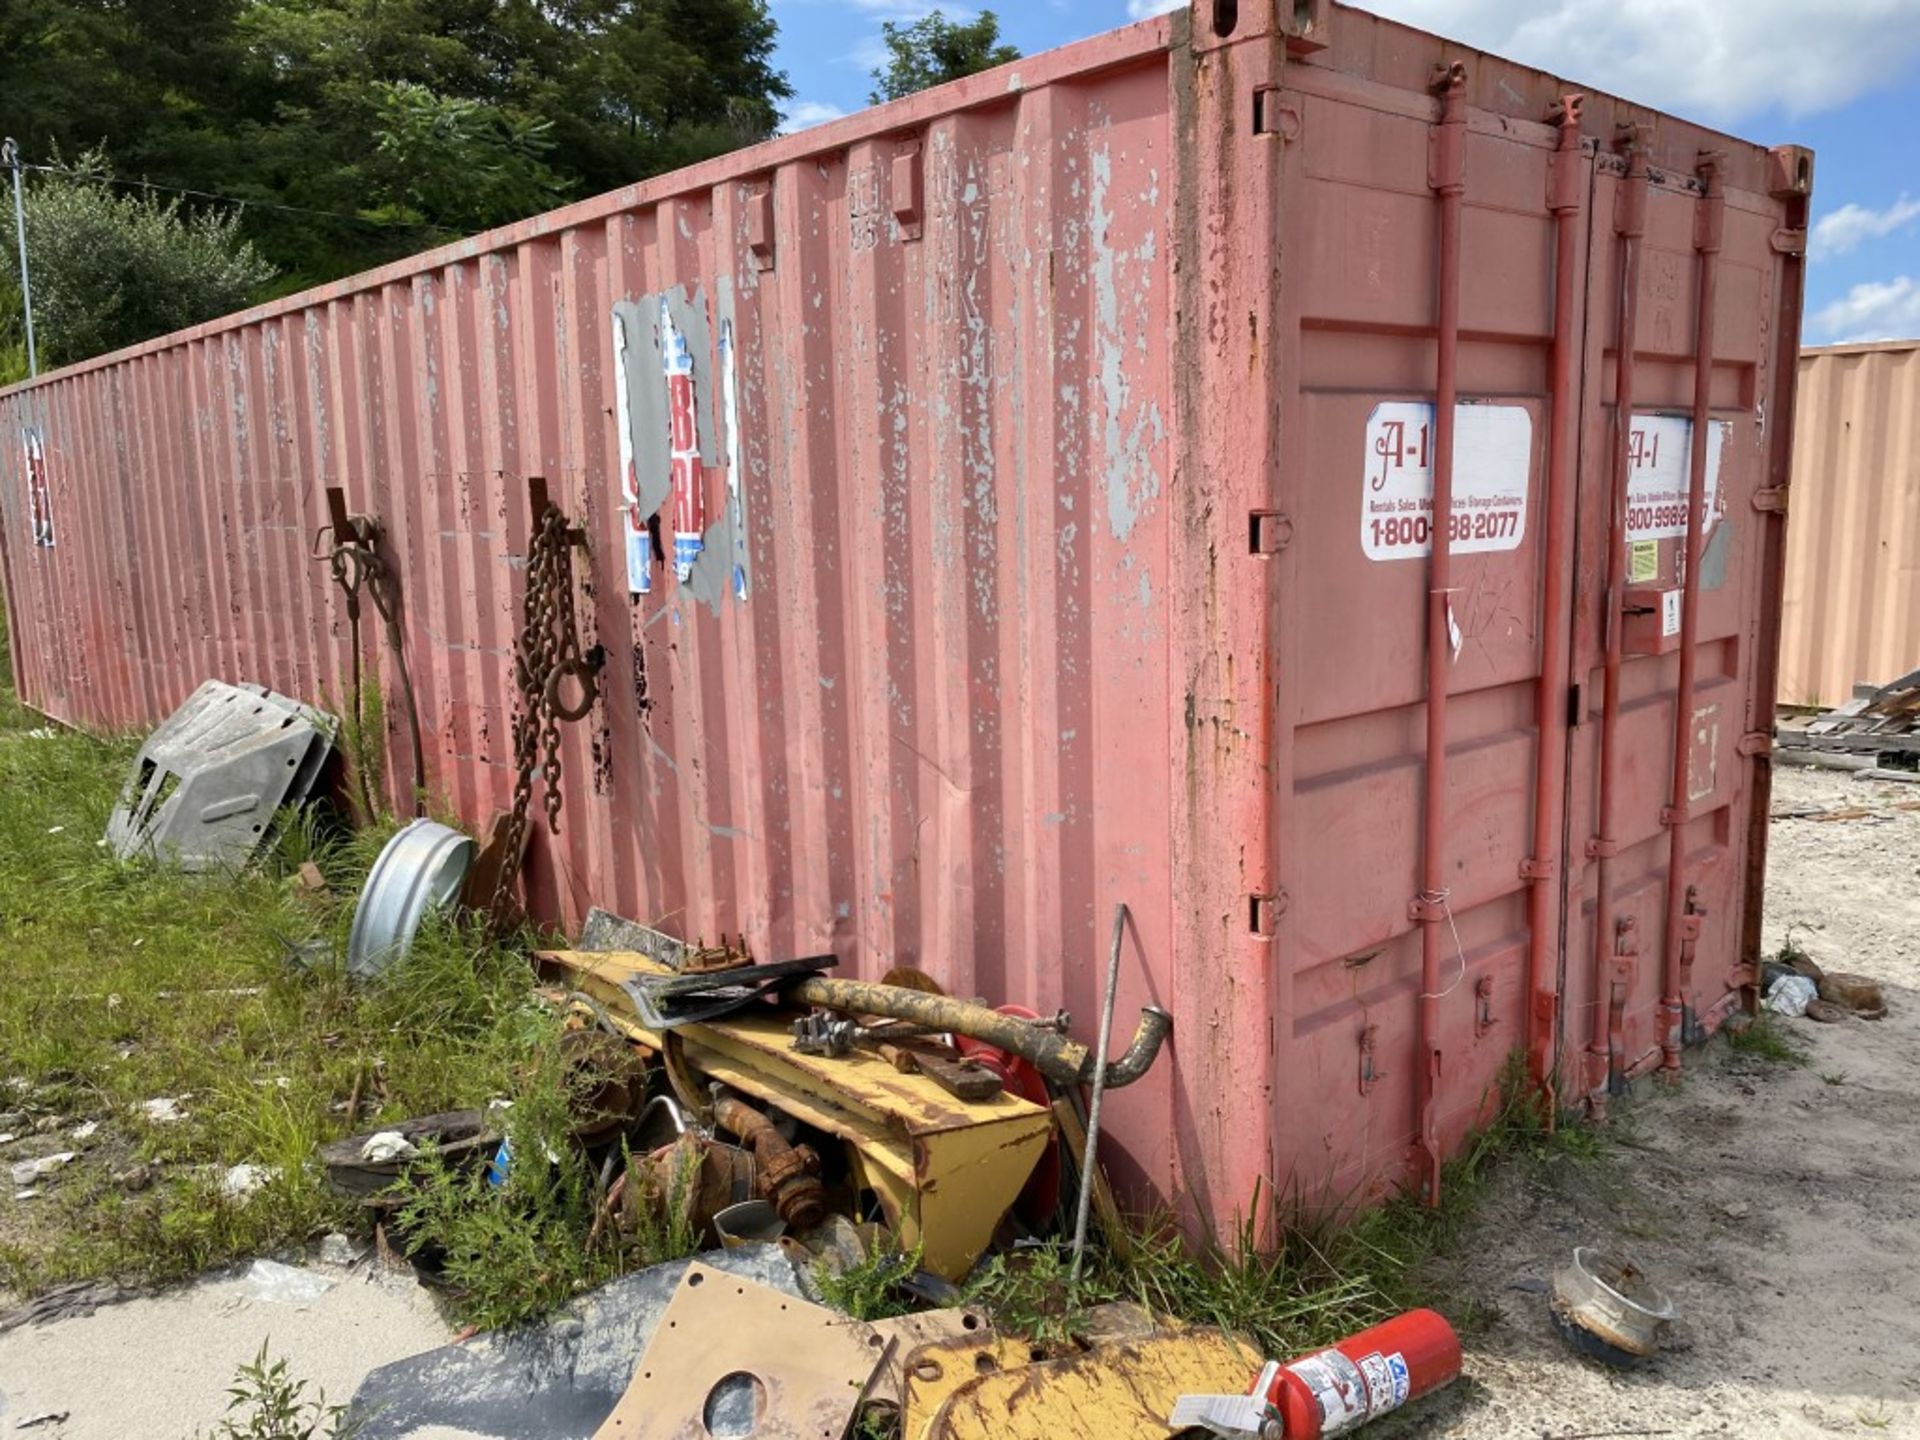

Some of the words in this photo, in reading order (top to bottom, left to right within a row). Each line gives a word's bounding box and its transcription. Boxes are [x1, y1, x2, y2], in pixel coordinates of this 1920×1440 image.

[1372, 422, 1428, 491] A-1
[1370, 500, 1396, 512] Rentals
[1398, 498, 1416, 511] Sales
[1370, 512, 1518, 546] 1-800-98-2077
